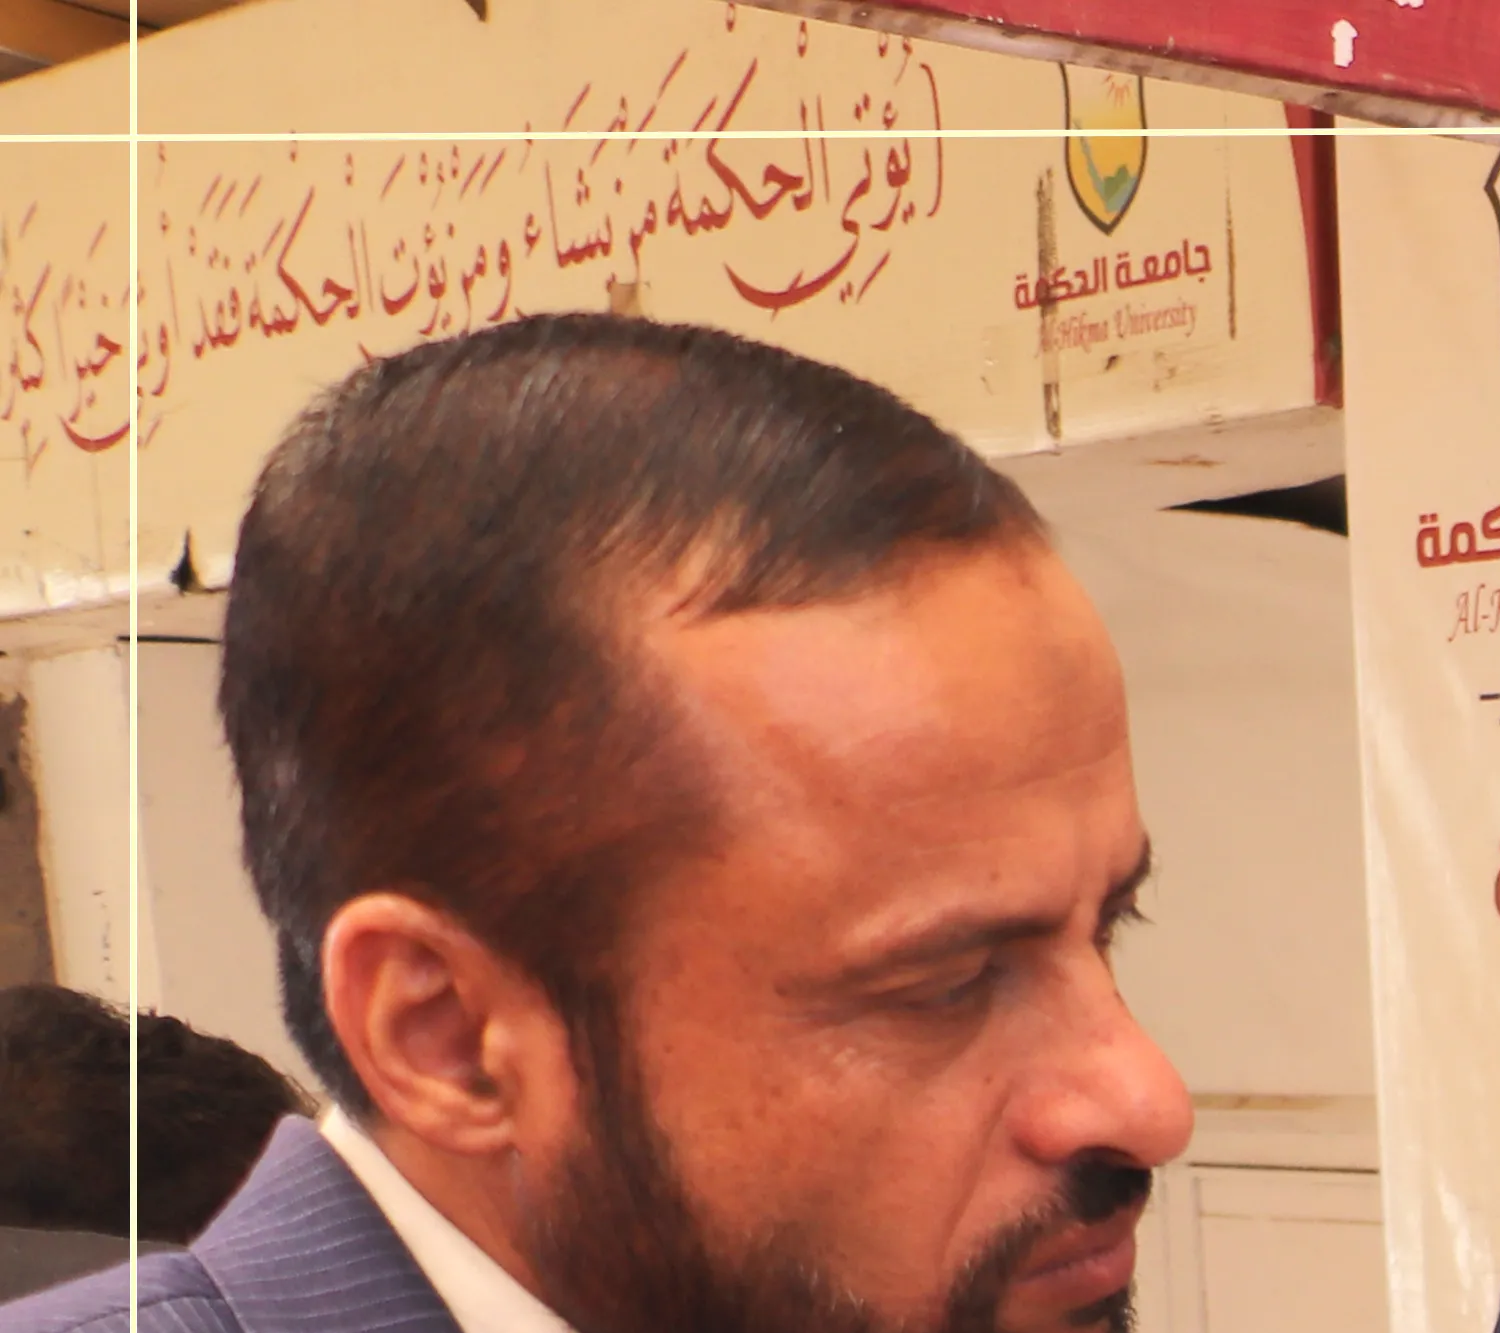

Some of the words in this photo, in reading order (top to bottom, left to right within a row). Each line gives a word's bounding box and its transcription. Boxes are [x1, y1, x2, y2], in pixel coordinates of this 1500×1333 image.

[1014, 256, 1108, 311] الحكمة
[1115, 239, 1212, 290] جامعة
[1114, 297, 1196, 339] University
